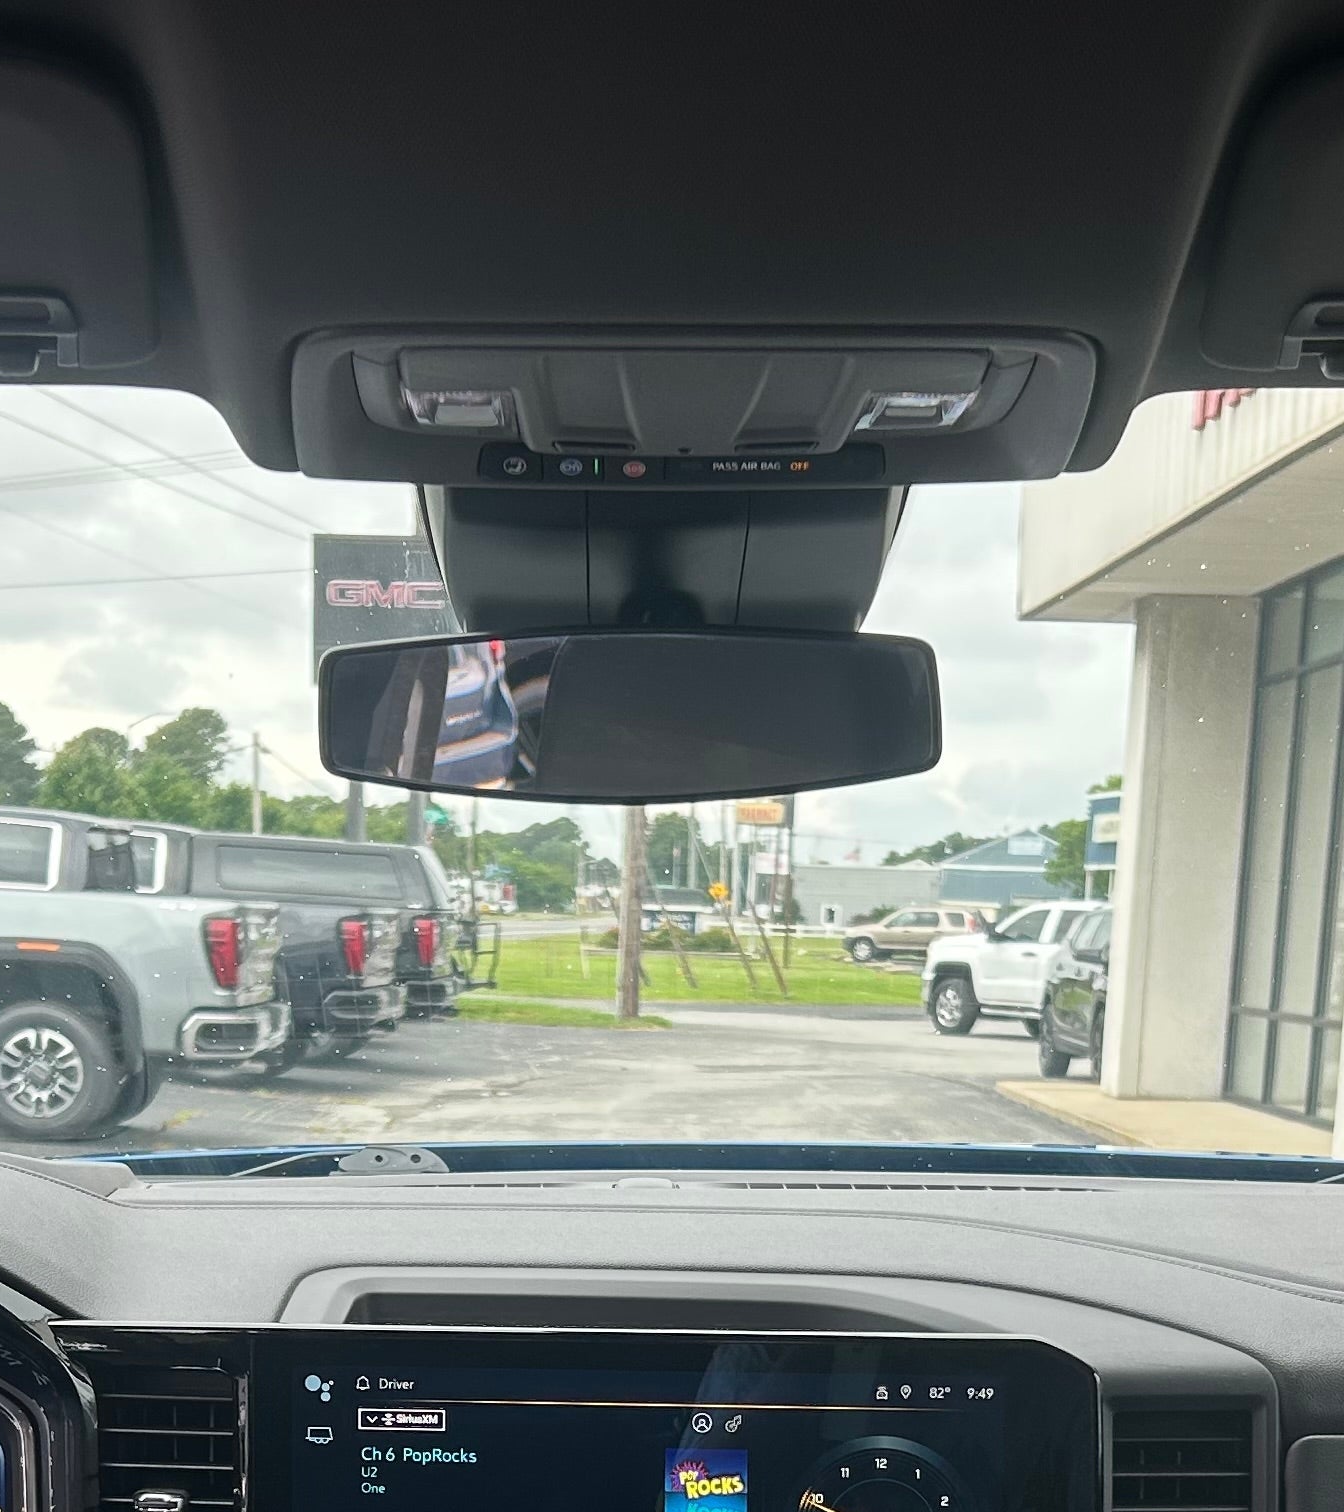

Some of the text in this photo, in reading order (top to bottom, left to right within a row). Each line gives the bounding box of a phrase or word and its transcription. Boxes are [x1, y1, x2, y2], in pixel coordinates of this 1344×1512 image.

[712, 462, 781, 471] PASS AIR BAG
[790, 461, 810, 471] OFF
[325, 579, 445, 611] GMC
[378, 1378, 415, 1390] Driver
[929, 1386, 951, 1399] 82°
[967, 1387, 994, 1400] 9:49
[361, 1447, 478, 1465] Ch 6 PopRocks
[874, 1458, 888, 1469] 12
[361, 1466, 378, 1478] U2
[840, 1468, 850, 1478] 11
[915, 1469, 921, 1479] 1
[361, 1482, 386, 1494] One
[685, 1477, 745, 1500] ROCKS
[940, 1496, 949, 1506] 2
